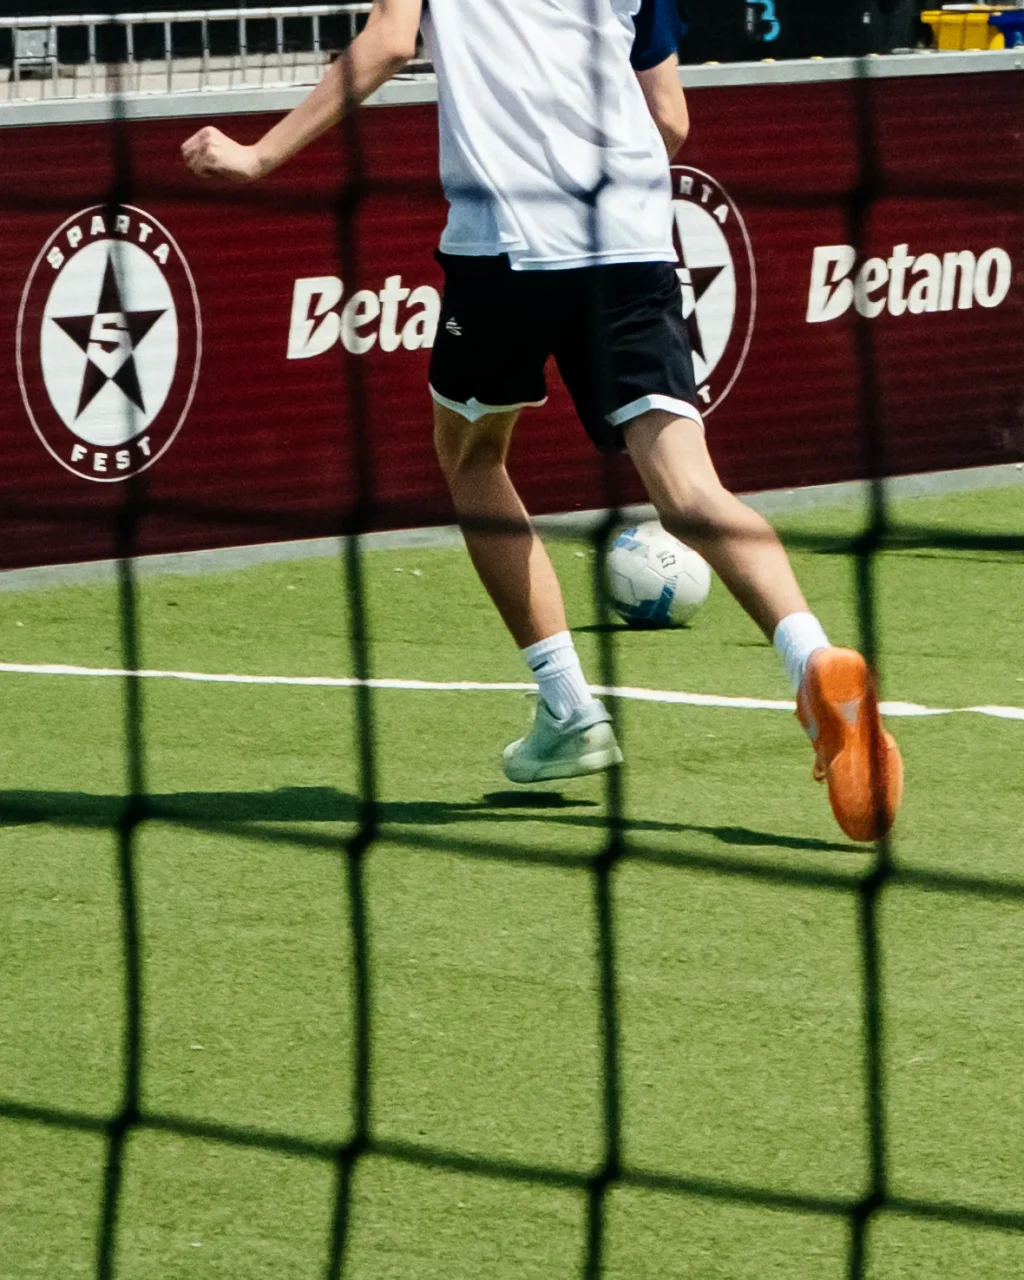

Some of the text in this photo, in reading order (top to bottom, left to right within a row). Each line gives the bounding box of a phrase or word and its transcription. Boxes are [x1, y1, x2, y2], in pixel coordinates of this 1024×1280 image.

[679, 175, 729, 224] RTA
[46, 215, 170, 270] SPARTA
[805, 243, 1012, 323] Betano
[286, 275, 441, 360] Beta
[70, 436, 151, 471] FEST
